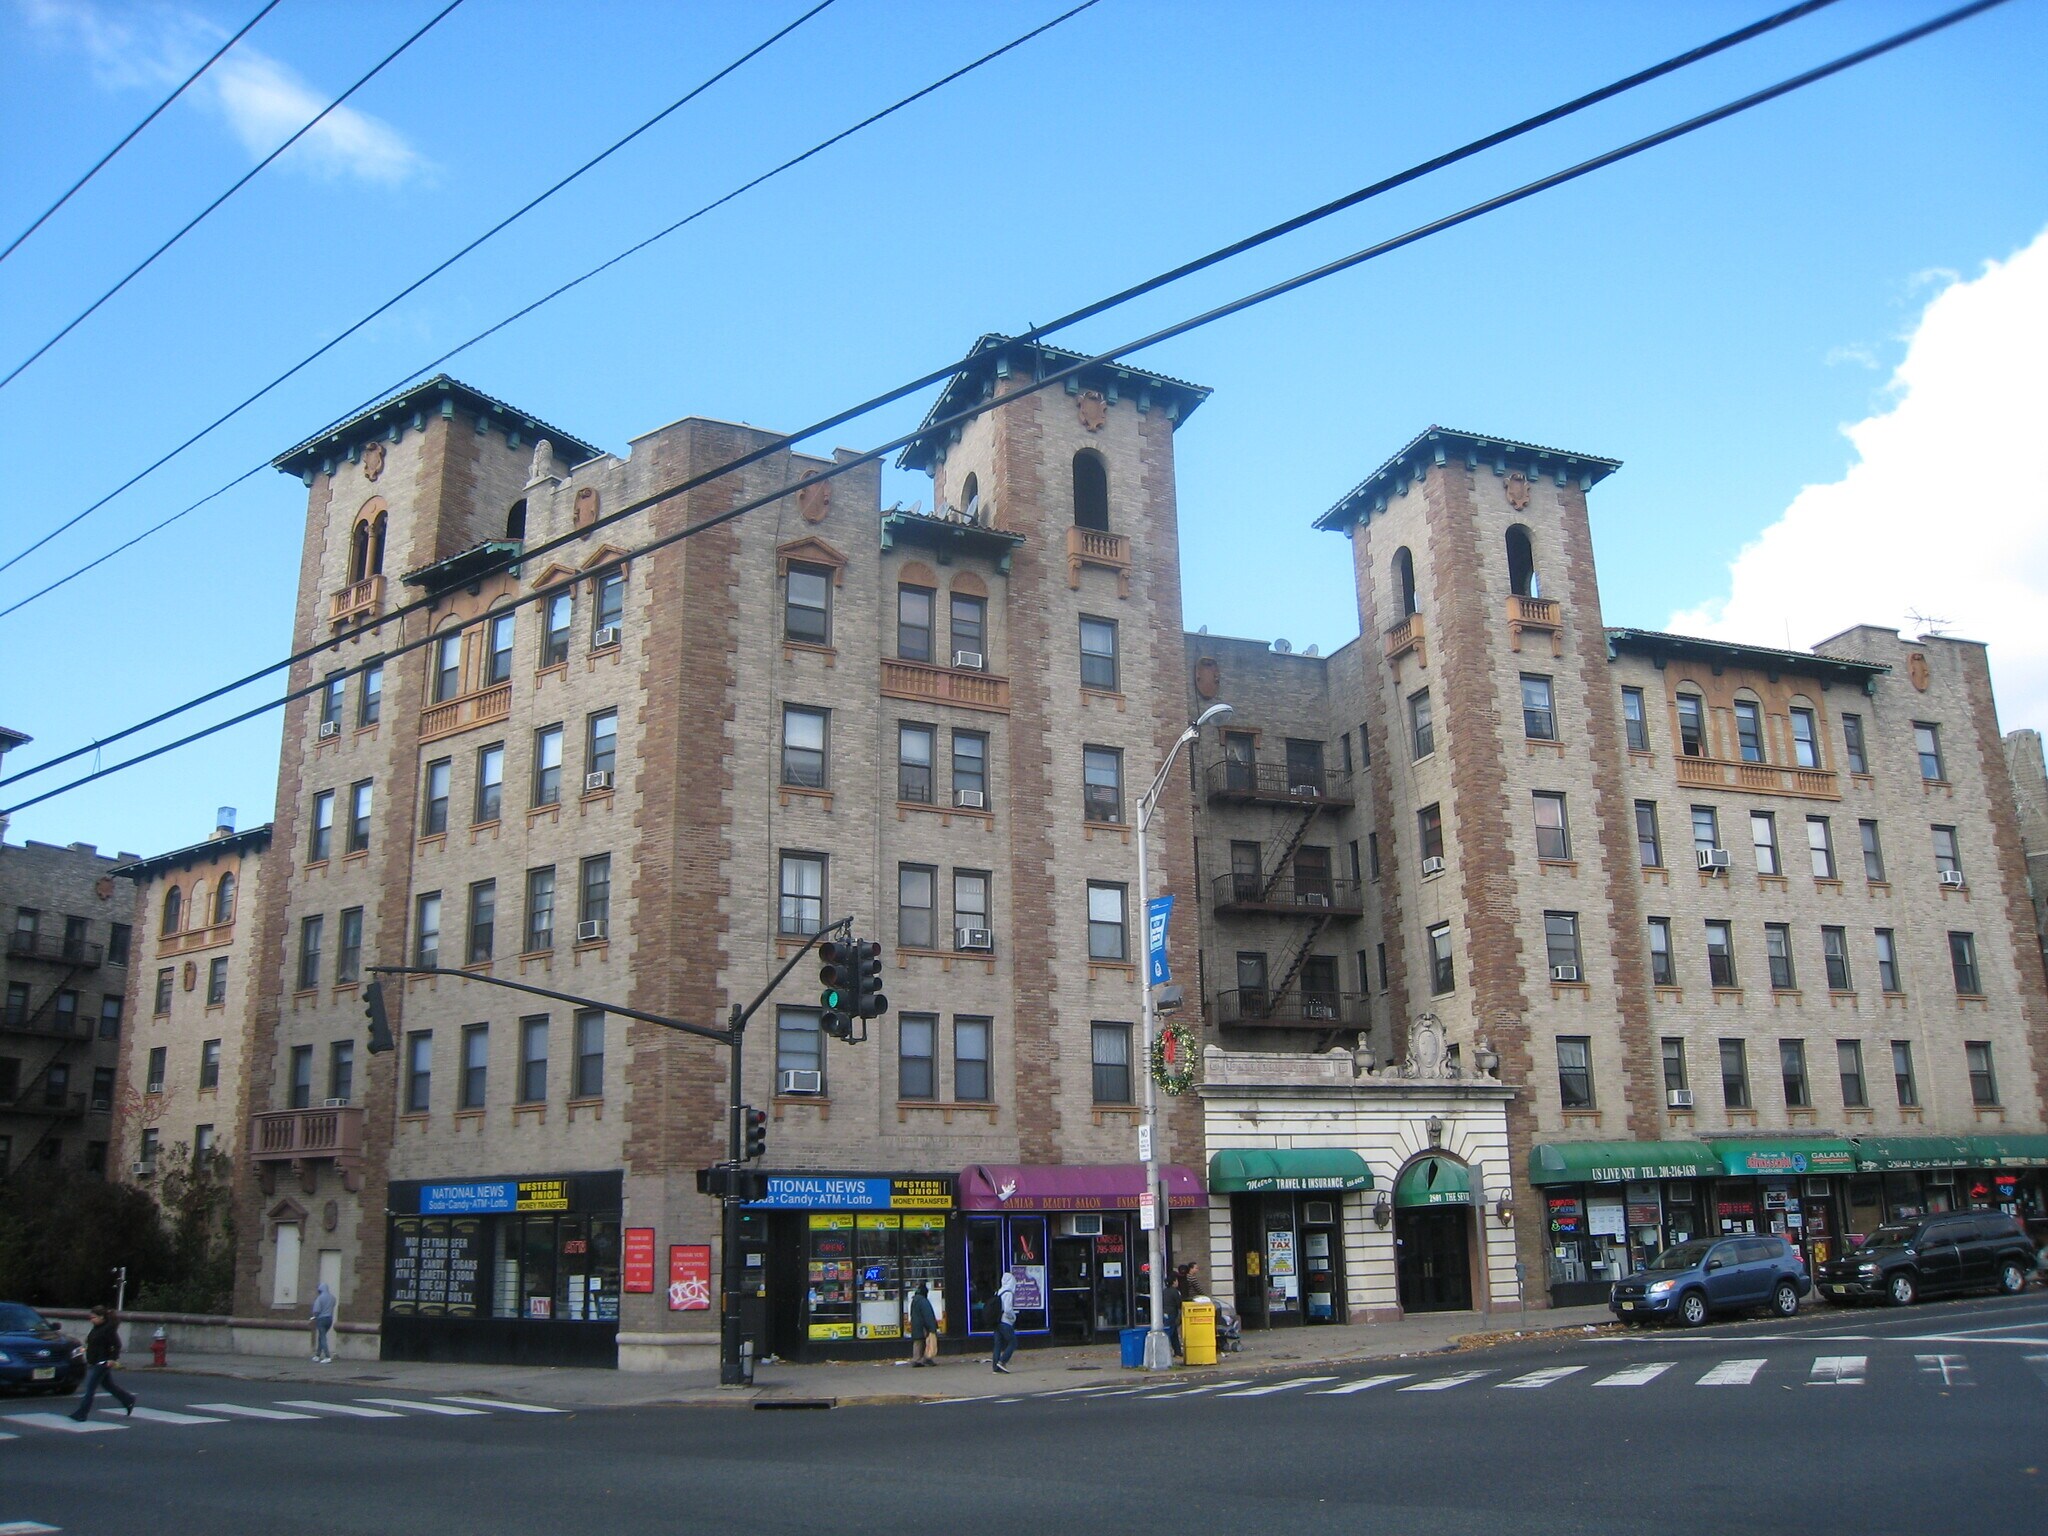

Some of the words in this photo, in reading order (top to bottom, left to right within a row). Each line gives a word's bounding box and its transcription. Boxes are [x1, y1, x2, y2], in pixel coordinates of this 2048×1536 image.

[1141, 1130, 1148, 1138] NO
[1591, 1168, 1603, 1180] US
[1603, 1168, 1621, 1179] LIVE
[1622, 1167, 1635, 1179] NET
[1641, 1166, 1658, 1178] TEL.
[1659, 1165, 1697, 1177] 201-216-1638
[519, 1182, 560, 1191] WESTERN
[767, 1181, 821, 1193] TIONAL
[826, 1181, 866, 1193] NEWS
[1246, 1178, 1272, 1190] Metro
[1276, 1178, 1300, 1189] TRAVEL
[1301, 1178, 1307, 1189] &
[1307, 1177, 1344, 1188] INSURANCE
[432, 1187, 475, 1199] NATIONAL
[477, 1185, 504, 1198] NEWS
[531, 1190, 559, 1199] UNION
[1445, 1192, 1457, 1202] THE
[1767, 1193, 1787, 1202] FedEx
[429, 1201, 446, 1210] Soda
[448, 1200, 469, 1211] Candy
[471, 1199, 488, 1208] ATM
[490, 1197, 508, 1208] Lotto
[517, 1201, 536, 1209] MONEY
[537, 1200, 567, 1209] TRANSFER
[780, 1194, 814, 1206] Candy
[818, 1194, 842, 1204] ATM
[847, 1194, 872, 1205] Lotto
[1003, 1197, 1034, 1209] SAMIA'S
[1043, 1197, 1071, 1209] BEAUTY
[1075, 1197, 1101, 1208] SALON
[1116, 1196, 1140, 1208] UNISE
[1168, 1196, 1195, 1206] 95-3999
[1549, 1199, 1576, 1207] COMPUTER
[1097, 1235, 1123, 1244] UNISEX
[395, 1258, 415, 1268] LOTTO
[422, 1259, 445, 1269] CANDY
[452, 1260, 478, 1270] CIGARS
[395, 1268, 410, 1278] ATM
[456, 1271, 475, 1281] SODA
[429, 1290, 446, 1301] CITY
[448, 1291, 463, 1302] BUS
[533, 1300, 551, 1314] ATM
